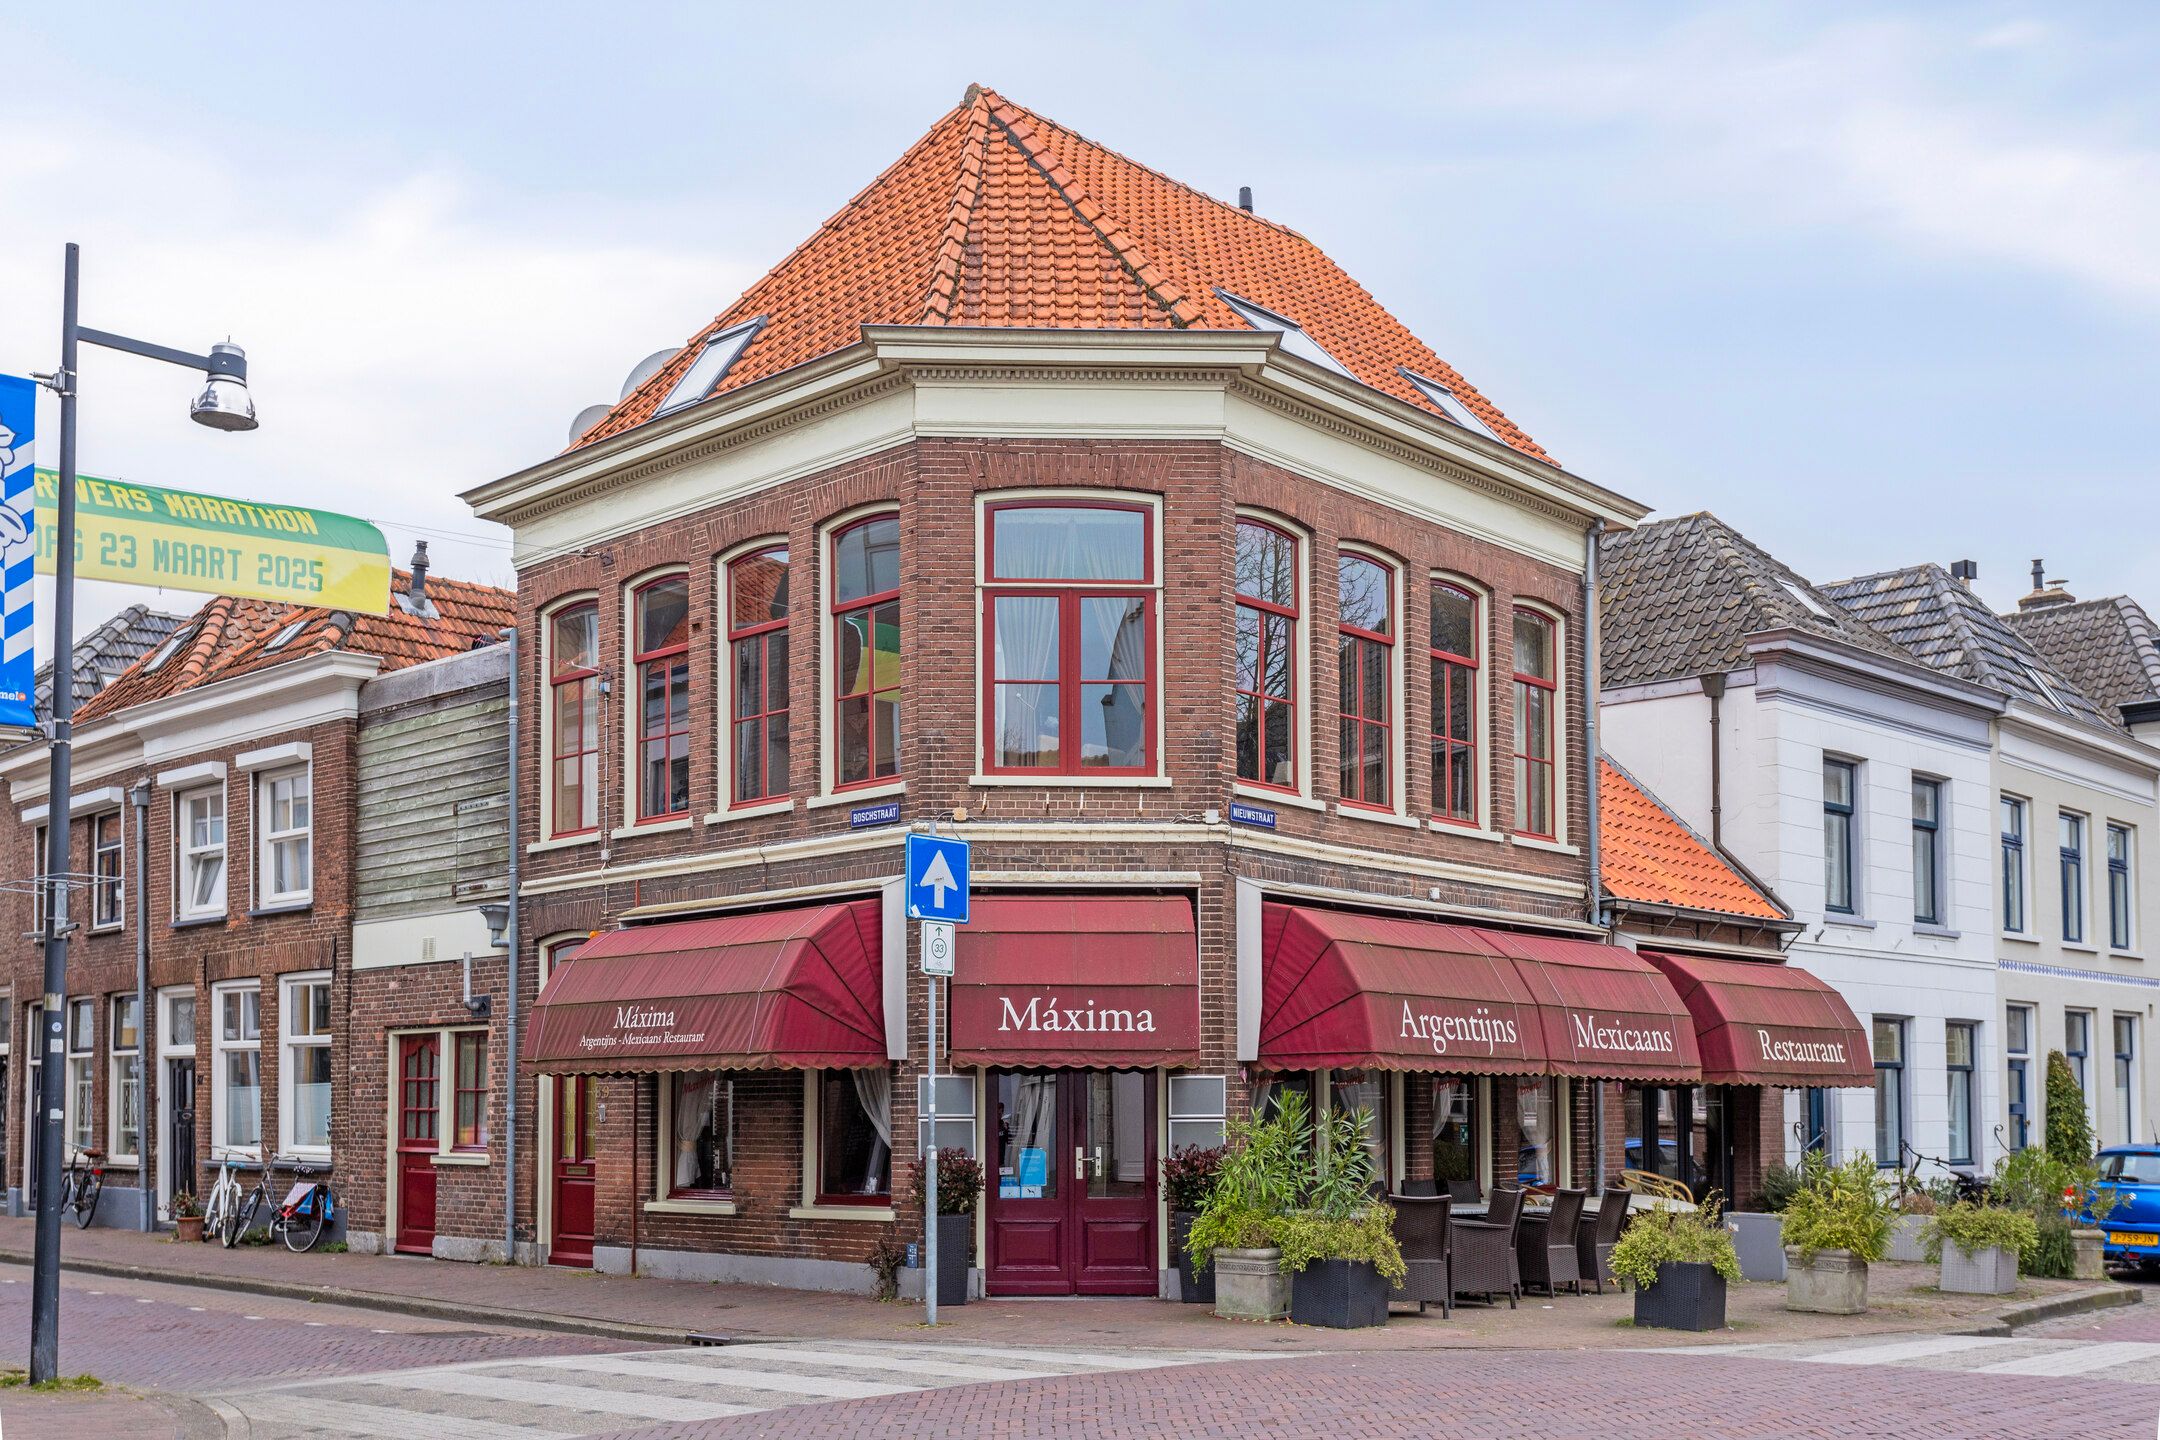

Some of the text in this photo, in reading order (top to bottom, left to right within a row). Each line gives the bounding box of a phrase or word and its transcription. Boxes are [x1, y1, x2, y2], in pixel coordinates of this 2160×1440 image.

[162, 493, 319, 536] MARATHON
[100, 532, 137, 568] 23
[152, 538, 242, 582] MAART
[257, 553, 324, 592] 2025
[853, 807, 897, 823] BOSCHSTRAAT
[1233, 807, 1274, 824] NIEUWSTRAAT
[934, 944, 944, 953] 33
[613, 1006, 675, 1029] Máxima
[998, 997, 1157, 1032] Máxima
[579, 1034, 617, 1051] Argentijns
[622, 1032, 662, 1045] Mexicaans
[663, 1030, 705, 1044] Restaurant
[1400, 999, 1846, 1063] Argentijns Mexicaans Restaurant
[2113, 1233, 2154, 1243] J-759-JN
